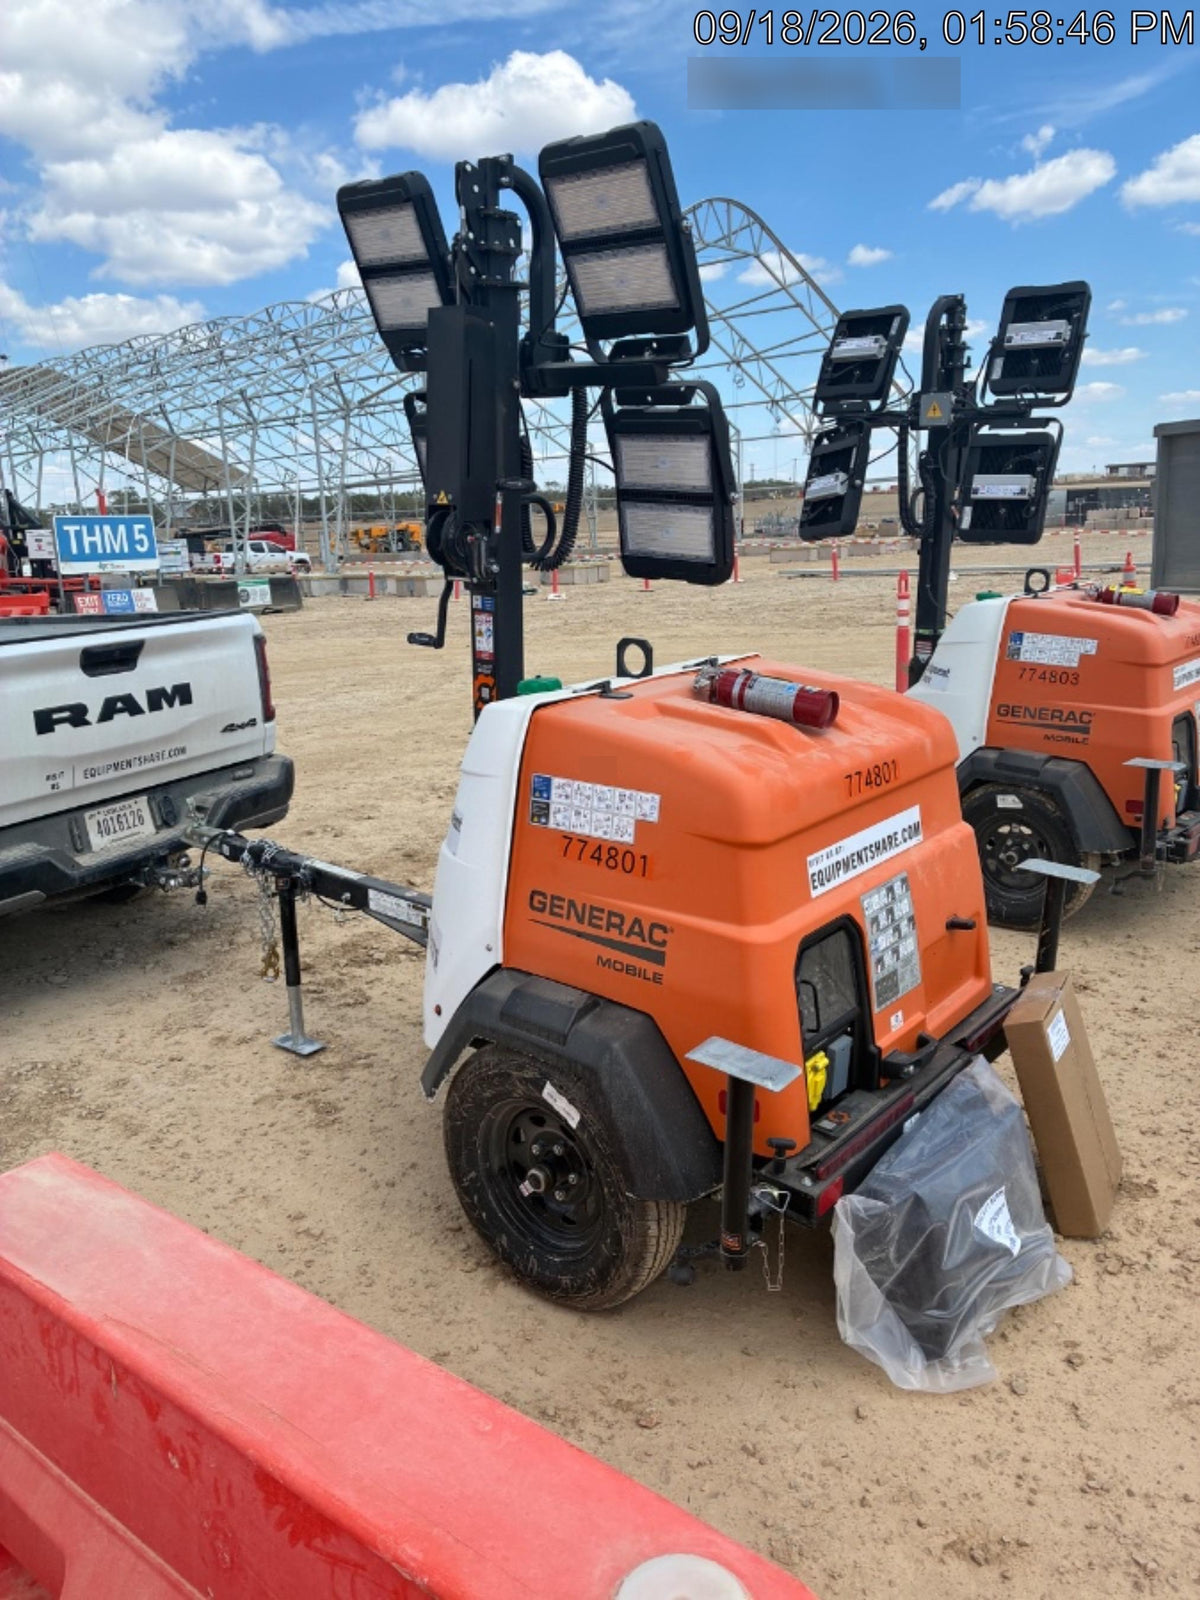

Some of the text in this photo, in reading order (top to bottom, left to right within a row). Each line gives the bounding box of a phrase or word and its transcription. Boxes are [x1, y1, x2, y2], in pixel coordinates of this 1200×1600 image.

[62, 524, 129, 555] THM
[132, 523, 150, 553] 5
[1018, 667, 1080, 686] 774803
[33, 682, 192, 736] RAM
[996, 703, 1093, 725] GENERAC
[1043, 734, 1089, 746] MOBILE
[83, 745, 187, 780] EQUIPMENTSHARE.COM
[843, 759, 898, 798] 774801
[97, 808, 145, 838] 4016126
[561, 835, 648, 878] 774801
[810, 820, 921, 891] EQUIPMENTSHARE.COM
[528, 889, 669, 949] GENERAC
[596, 954, 664, 986] MOBILE
